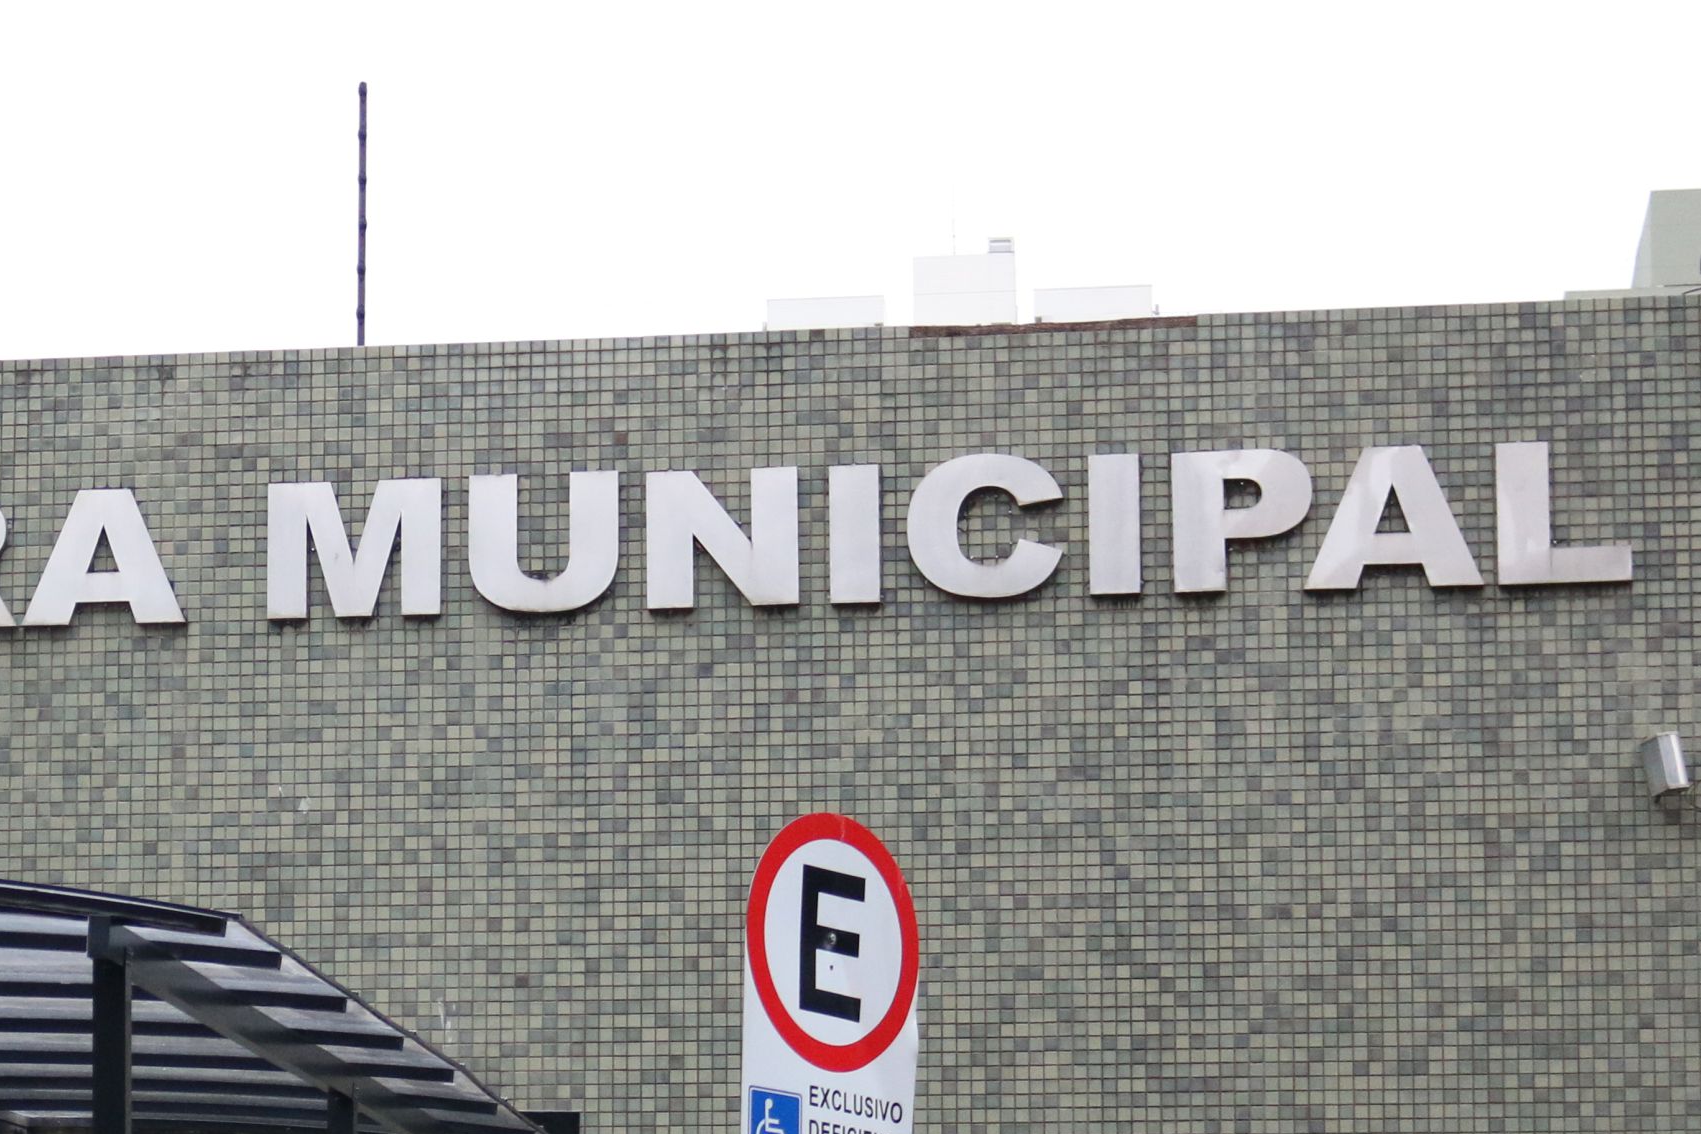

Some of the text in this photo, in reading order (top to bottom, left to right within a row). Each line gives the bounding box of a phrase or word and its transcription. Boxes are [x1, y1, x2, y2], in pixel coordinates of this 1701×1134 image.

[266, 441, 1633, 618] MUNICIPAL
[799, 864, 866, 1022] E
[808, 1085, 903, 1124] EXCLUSIVO
